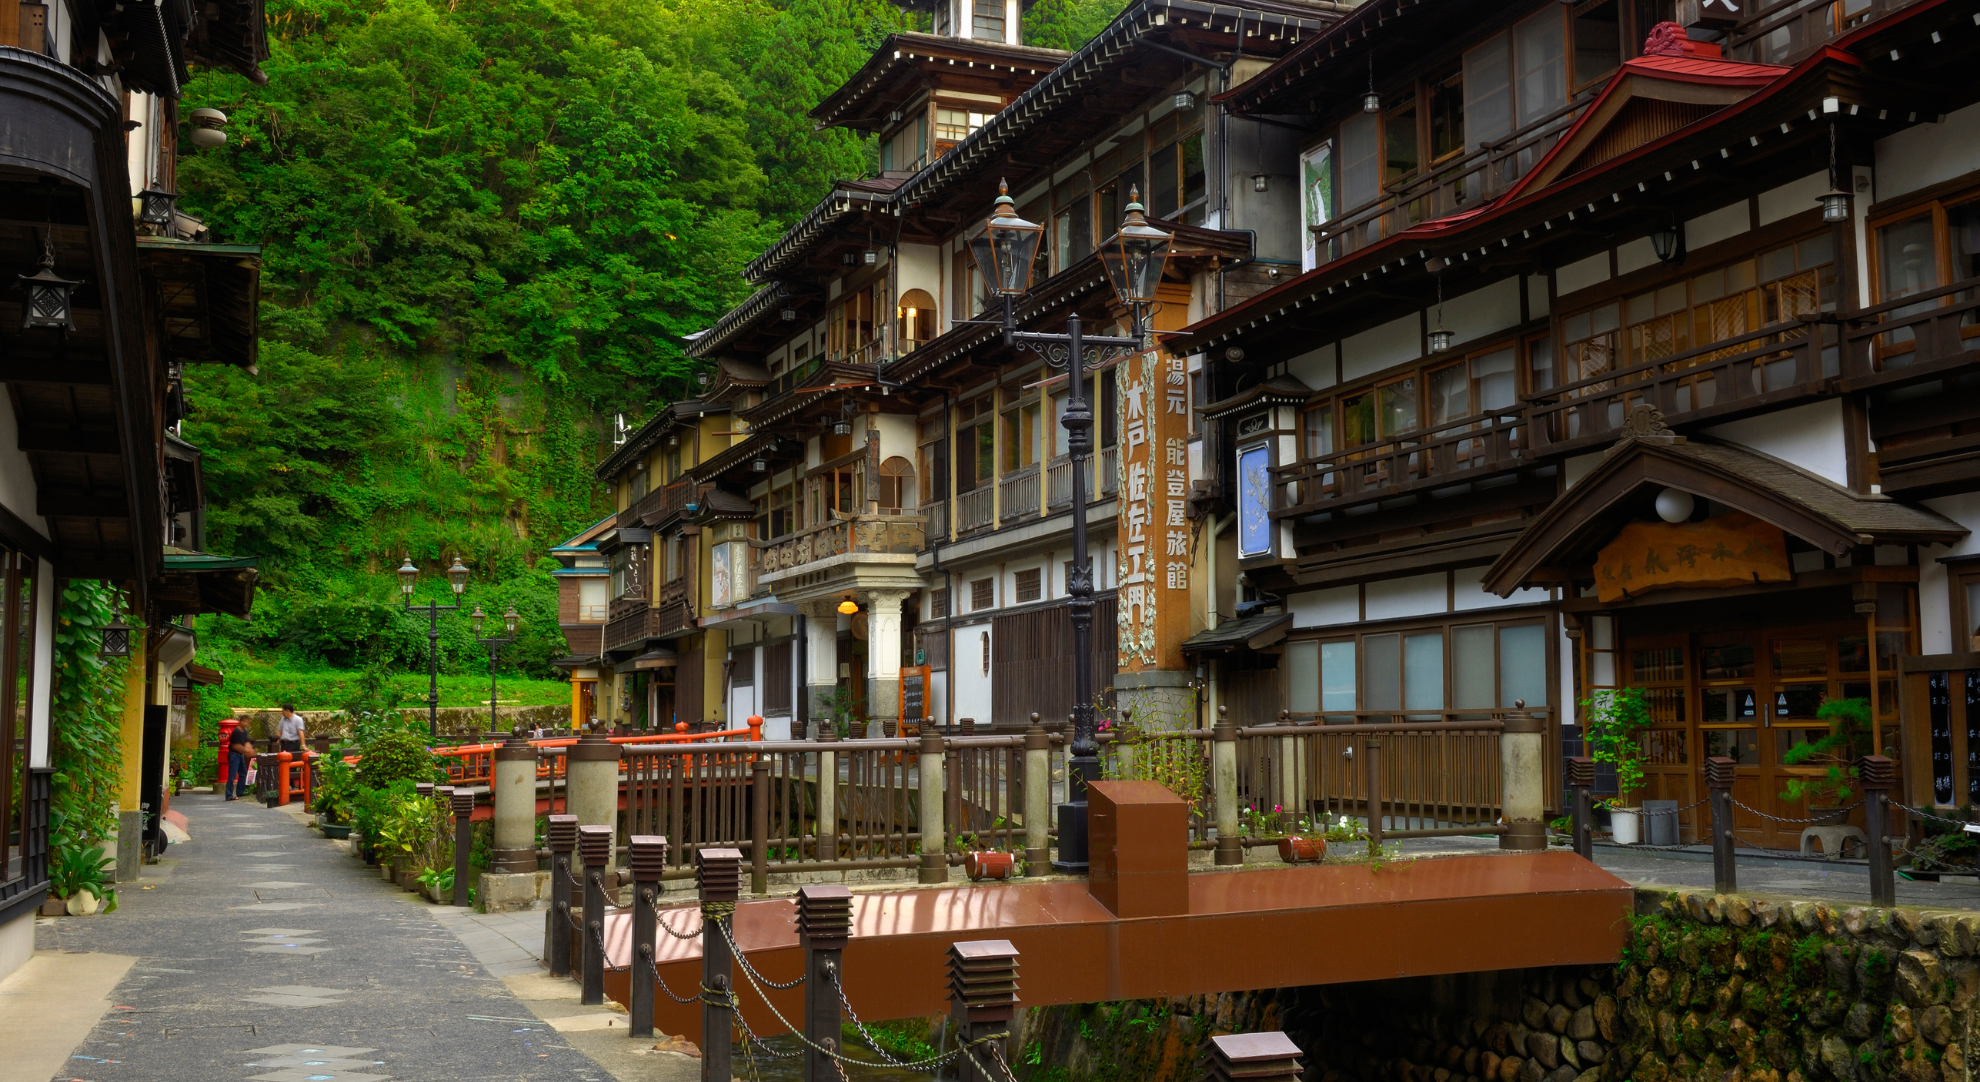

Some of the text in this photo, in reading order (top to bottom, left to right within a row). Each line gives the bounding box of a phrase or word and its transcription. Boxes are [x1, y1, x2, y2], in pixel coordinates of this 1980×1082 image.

[1165, 359, 1187, 590] 湯元 能登屋旅館
